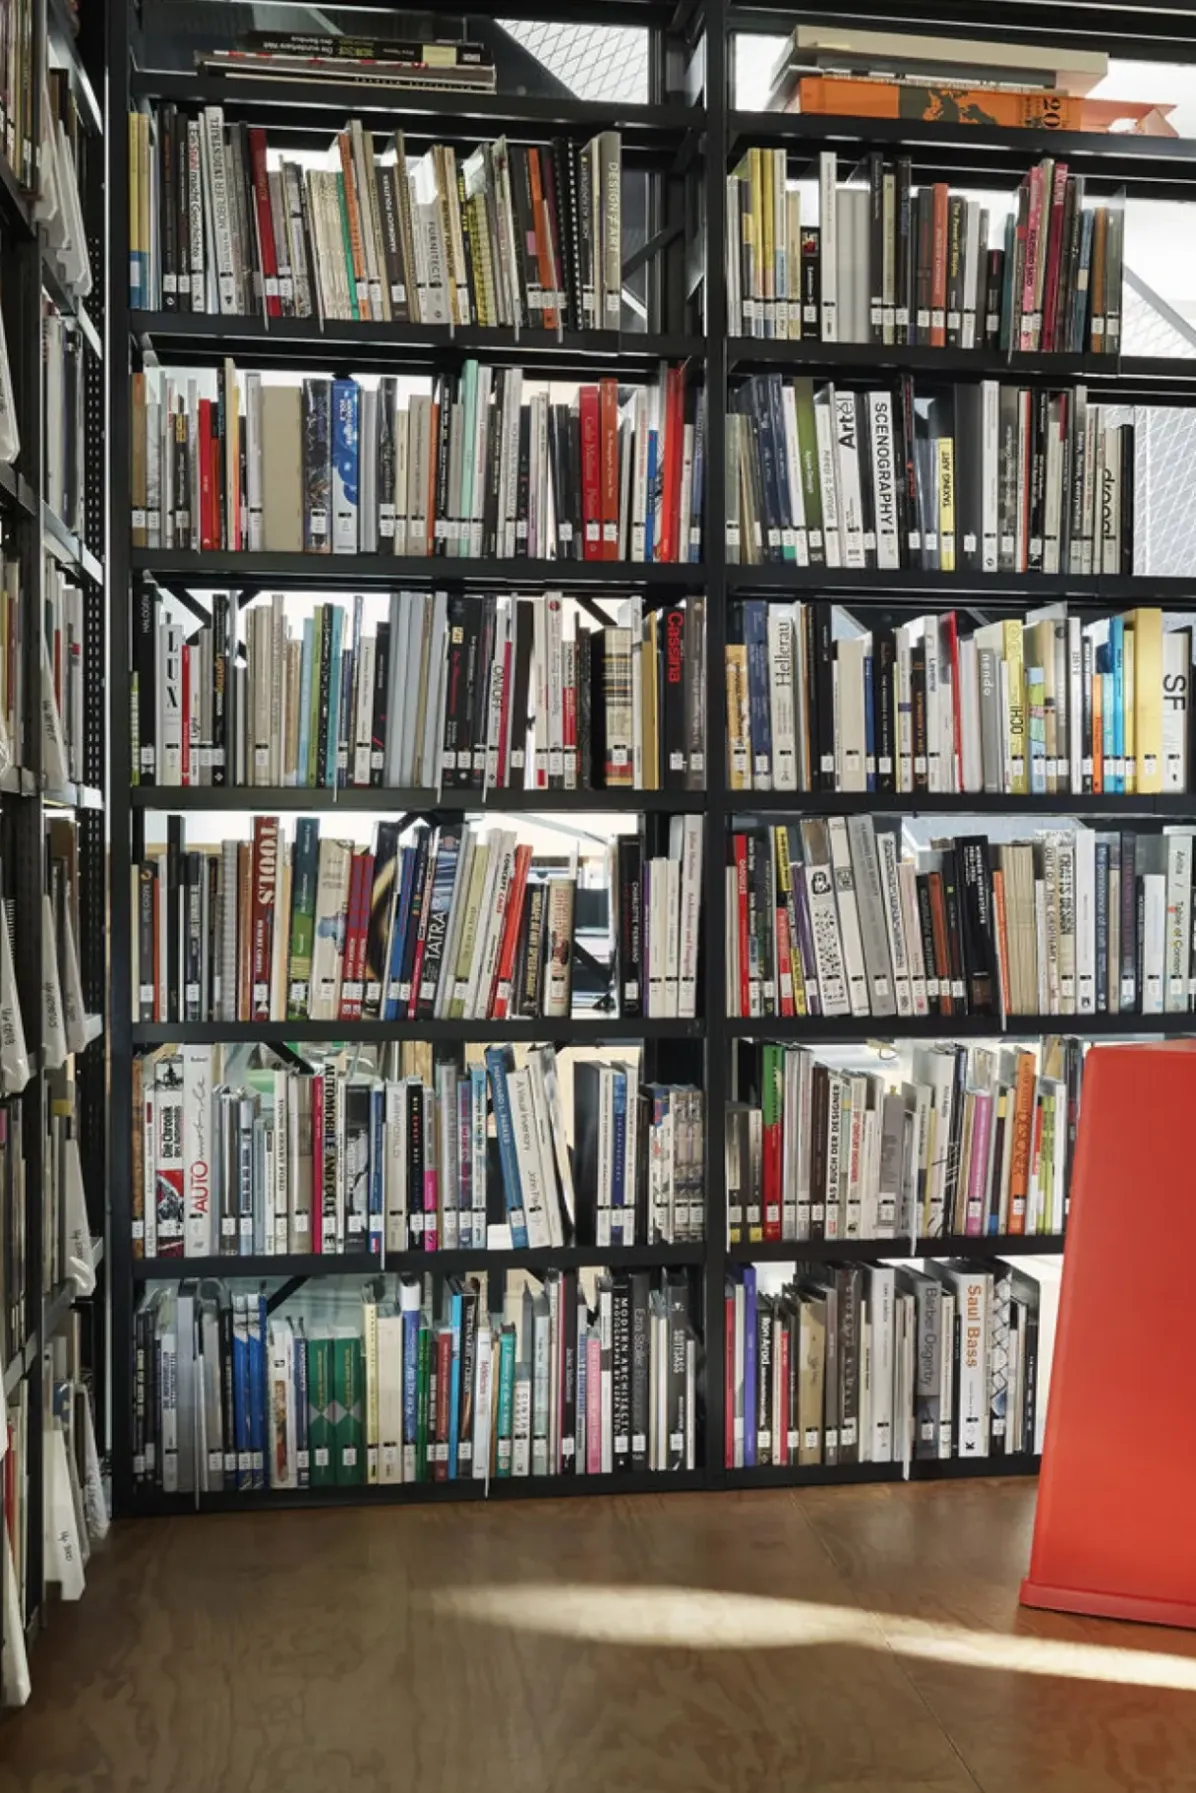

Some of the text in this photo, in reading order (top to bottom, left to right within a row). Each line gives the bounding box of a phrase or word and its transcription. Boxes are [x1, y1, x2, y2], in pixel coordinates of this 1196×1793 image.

[214, 179, 225, 229] MOBILIER
[874, 403, 893, 526] SCENOGRAPHY
[941, 452, 951, 471] ART
[667, 612, 684, 683] Cassina
[773, 622, 792, 687] Hellerau
[981, 654, 992, 697] nendo
[1163, 674, 1186, 711] SF
[258, 824, 276, 905] TOOLS
[499, 853, 512, 891] CONCEPT
[631, 882, 639, 922] CHARLOTTE
[425, 910, 446, 960] TATRA
[324, 1064, 337, 1149] AUTOMOBILE
[516, 1089, 528, 1112] Visual
[831, 1084, 840, 1133] DESIGNER
[160, 1106, 173, 1158] Die Chronik
[518, 1113, 531, 1151] Inventory
[830, 1136, 839, 1154] DER
[324, 1155, 337, 1182] AND
[829, 1156, 838, 1183] BUCH
[620, 1298, 629, 1353] MODERN
[634, 1308, 646, 1331] Ezra
[761, 1318, 771, 1337] Ron
[922, 1287, 937, 1386] Barber Osgerby
[966, 1285, 981, 1367] Saul Bass
[634, 1334, 646, 1367] Stoller
[760, 1339, 771, 1365] Arad
